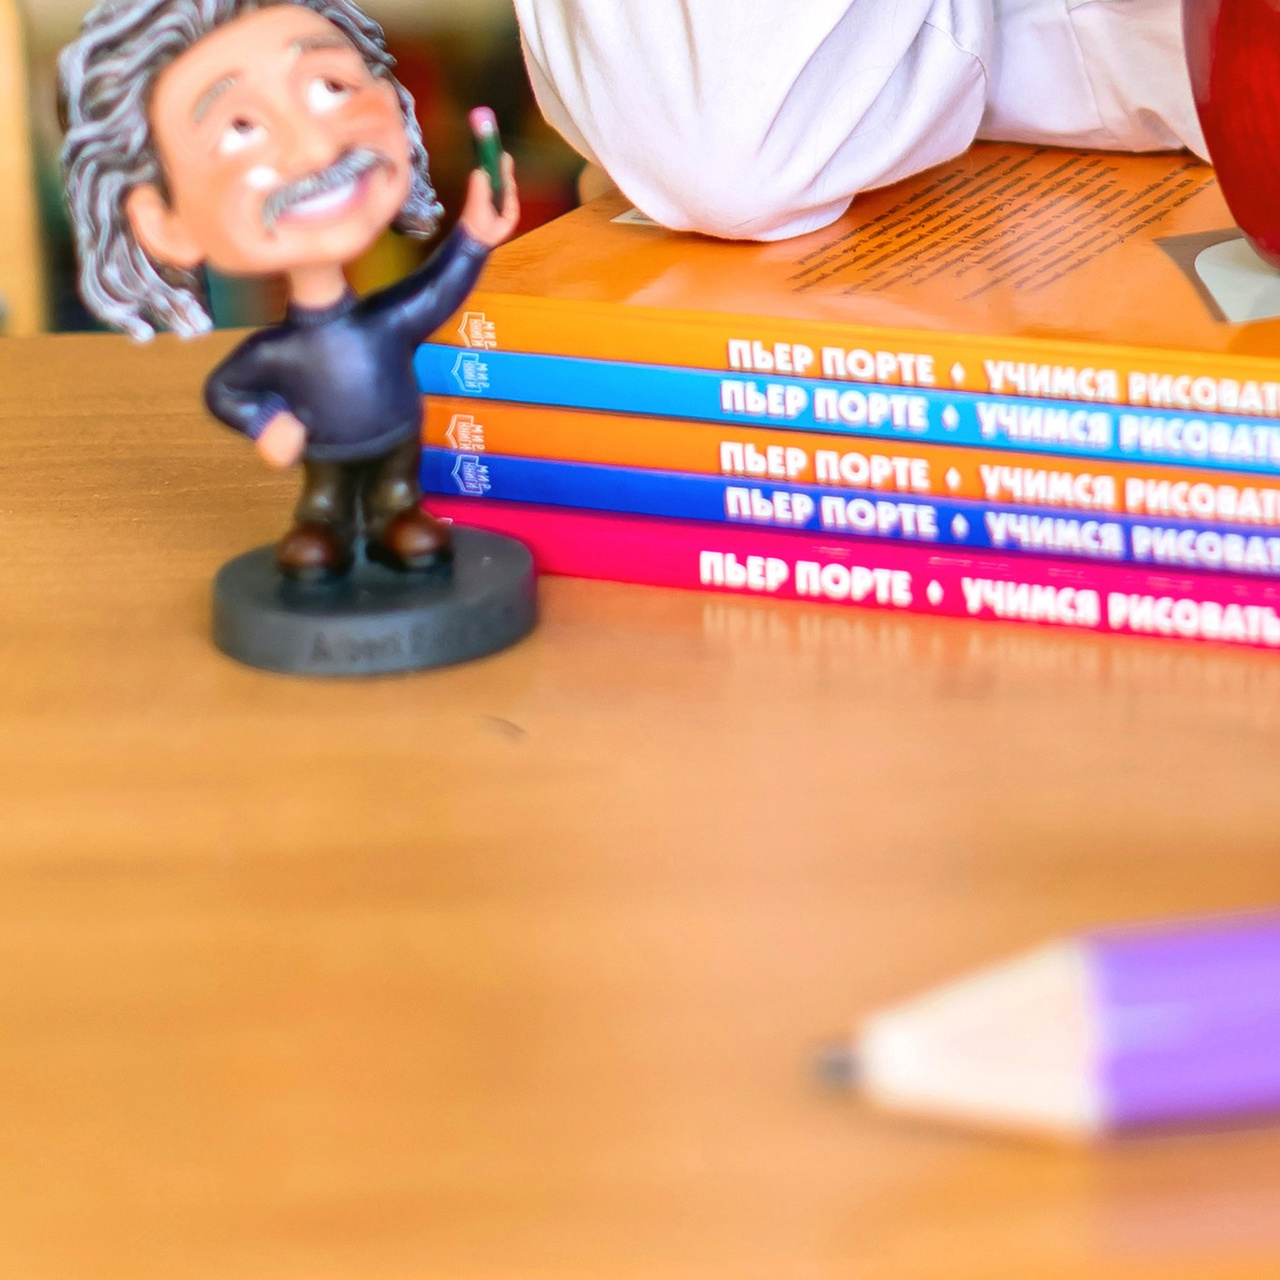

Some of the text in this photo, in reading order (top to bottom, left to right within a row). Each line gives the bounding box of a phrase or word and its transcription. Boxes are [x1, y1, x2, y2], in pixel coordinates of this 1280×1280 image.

[729, 340, 813, 373] ПЬЕР
[823, 347, 934, 386] ПОРТЕ
[986, 361, 1118, 402] УЧИМСЯ
[721, 380, 807, 418] ПЬЕР
[814, 389, 927, 431] ПОРТЕ
[977, 402, 1111, 447] УЧИМСЯ
[721, 442, 807, 477] ПЬЕР
[816, 451, 929, 490] ПОРТЕ
[981, 465, 1115, 510] УЧИМСЯ
[727, 488, 813, 523] ПЬЕР
[822, 496, 937, 536] ПОРТЕ
[987, 512, 1123, 555] УЧИМСЯ
[700, 551, 788, 589] ПЬЕР
[796, 561, 911, 604] ПОРТЕ
[963, 578, 1098, 624] УЧИМСЯ
